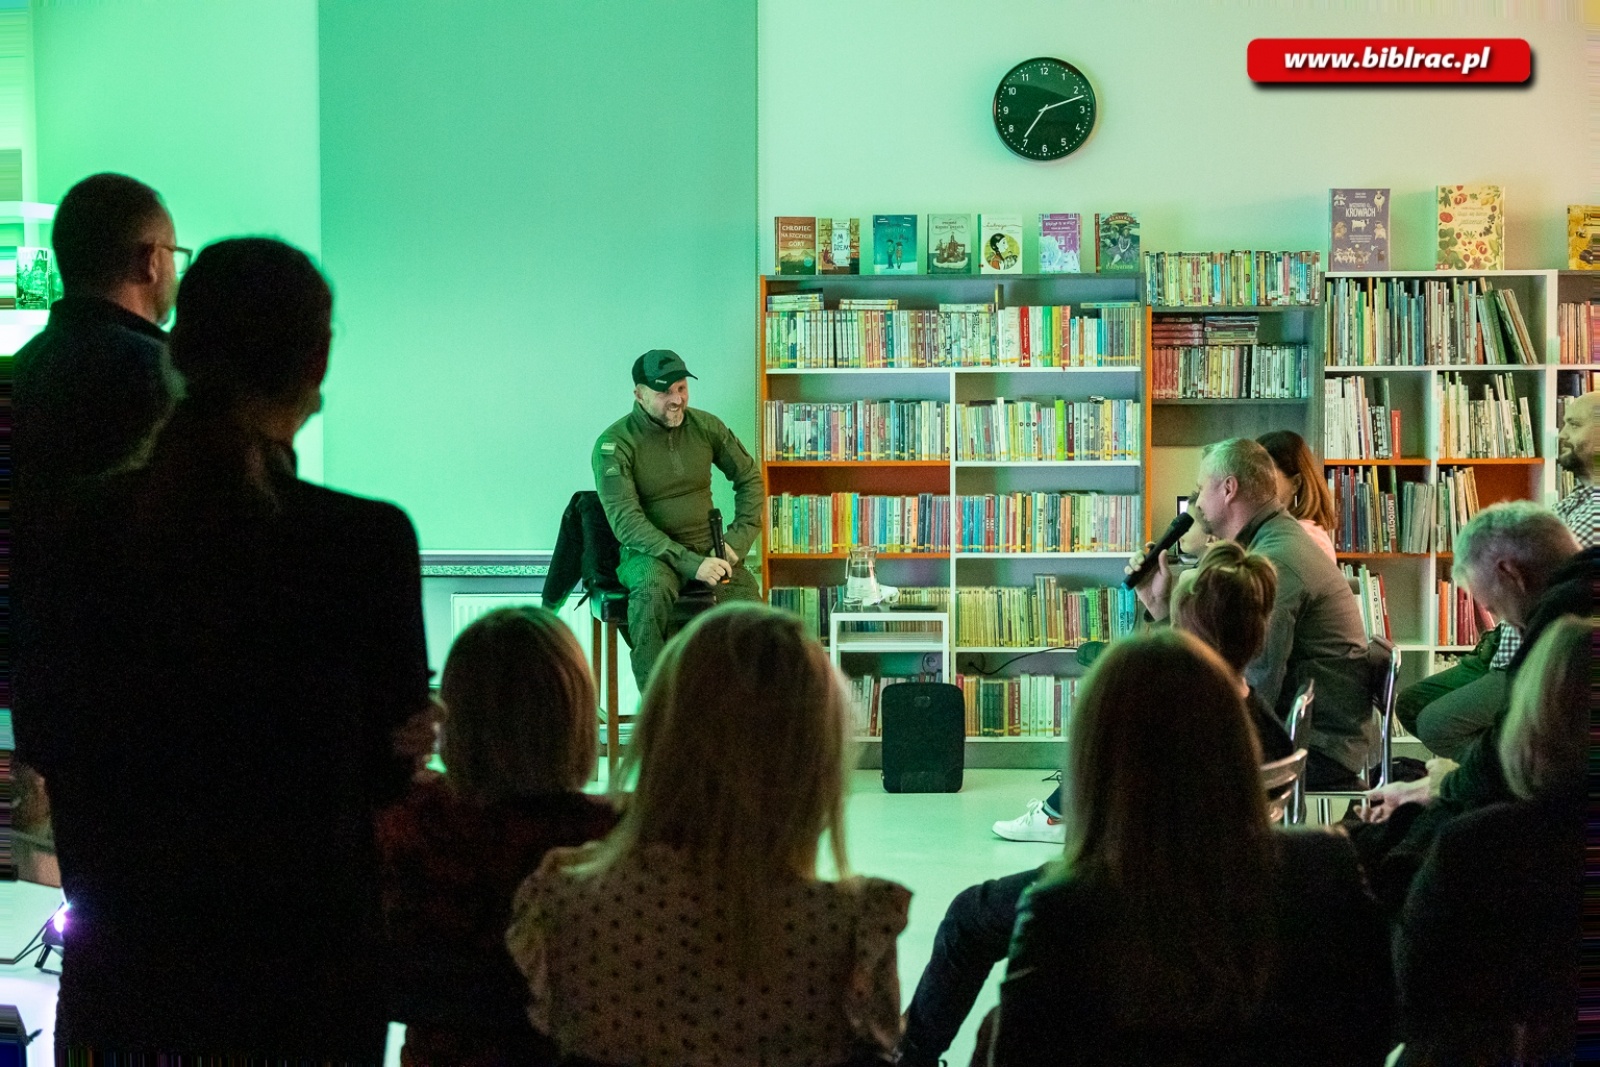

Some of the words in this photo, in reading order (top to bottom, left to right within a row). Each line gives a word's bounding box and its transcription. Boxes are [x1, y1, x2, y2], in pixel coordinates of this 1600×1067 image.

[1040, 67, 1049, 75] 12
[1008, 87, 1017, 95] 10
[1073, 86, 1079, 94] 2
[1003, 106, 1009, 114] 9
[1079, 106, 1085, 114] 3
[1008, 124, 1014, 133] 8
[1075, 123, 1081, 131] 4
[1022, 139, 1029, 147] 7
[1060, 138, 1067, 146] 5
[1041, 144, 1048, 152] 6
[1345, 207, 1376, 217] KROWACH
[1388, 499, 1397, 540] MOTOCYKLE
